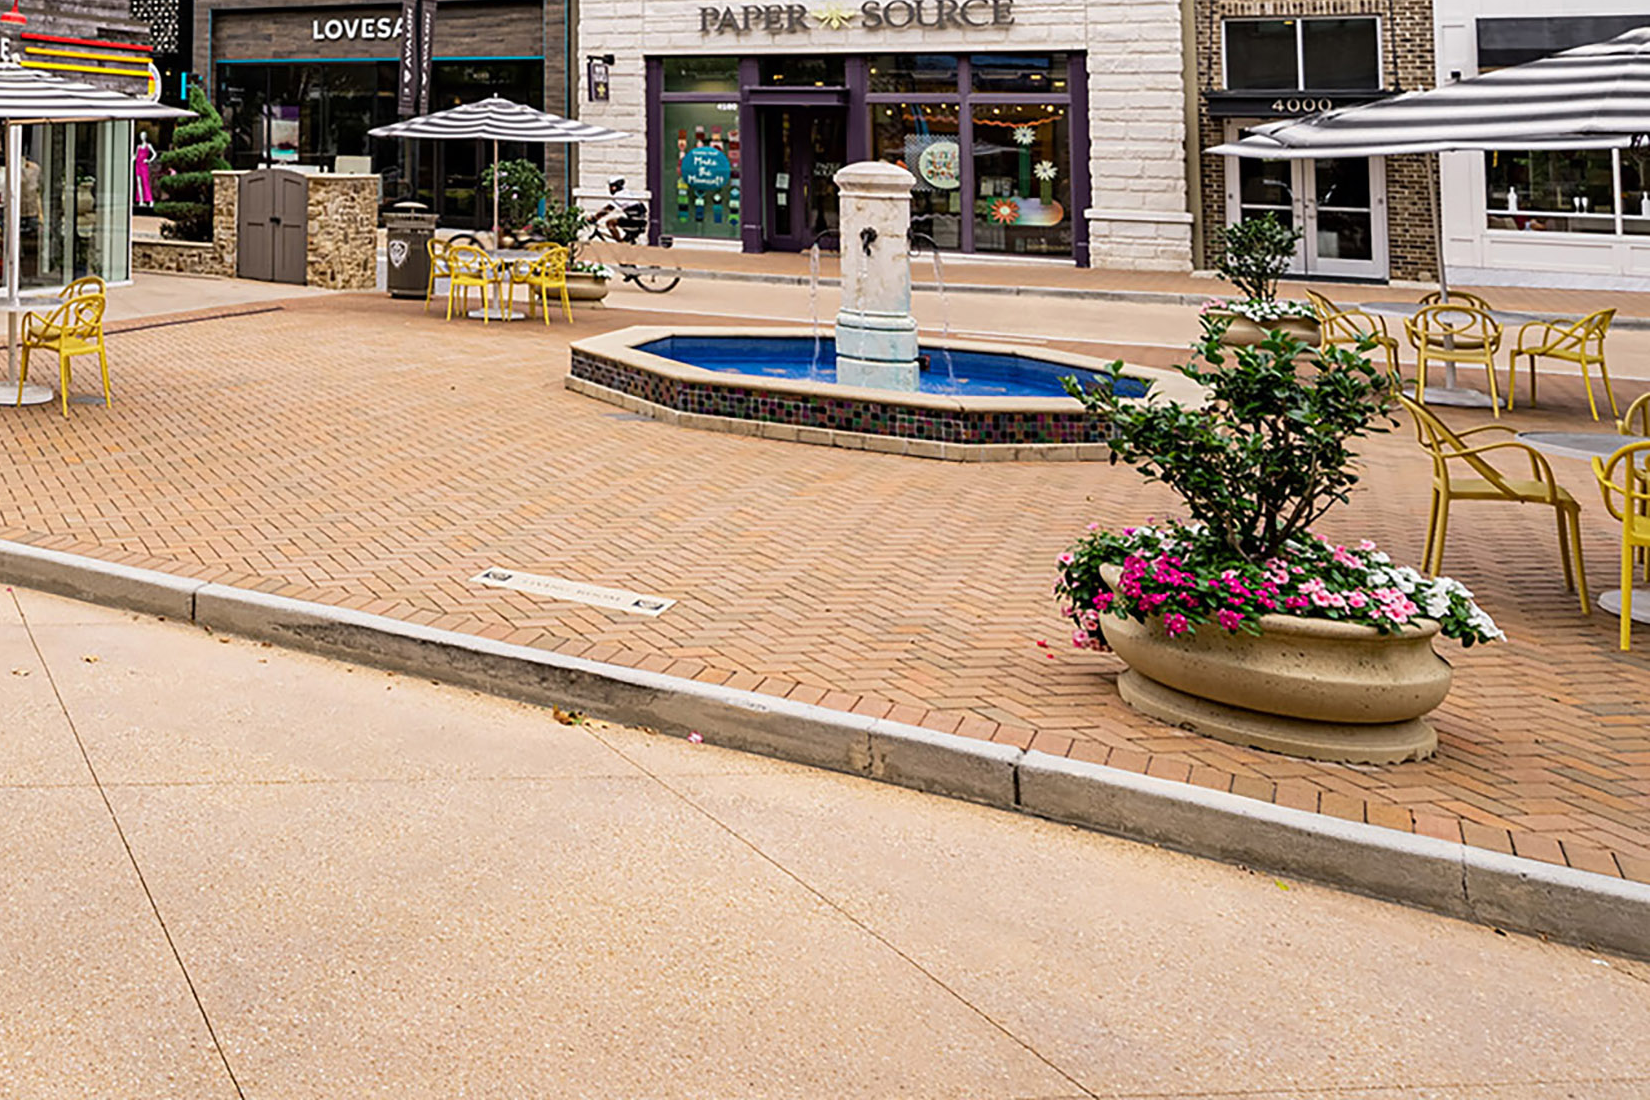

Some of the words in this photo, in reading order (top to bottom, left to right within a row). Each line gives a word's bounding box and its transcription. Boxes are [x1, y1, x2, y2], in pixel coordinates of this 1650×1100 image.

[312, 16, 403, 40] LOVESA
[699, 3, 811, 32] PAPER
[1271, 98, 1332, 113] 4000
